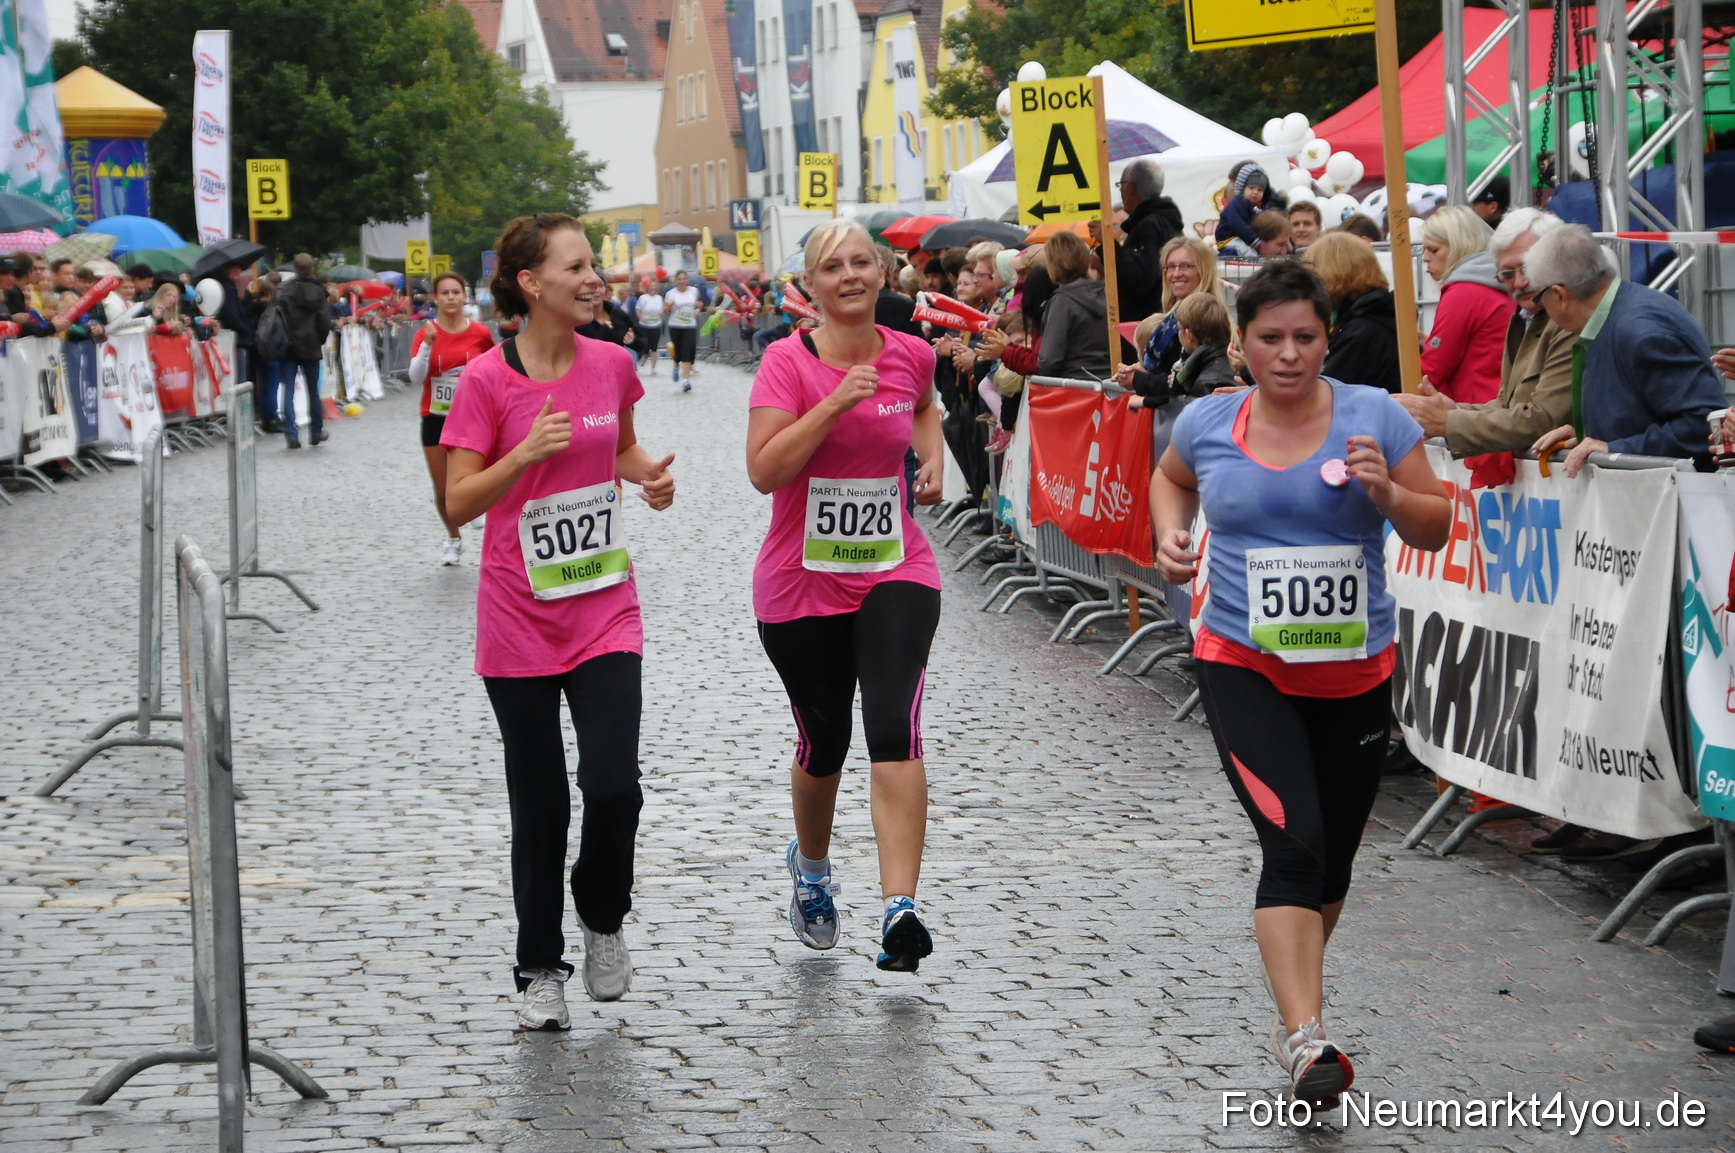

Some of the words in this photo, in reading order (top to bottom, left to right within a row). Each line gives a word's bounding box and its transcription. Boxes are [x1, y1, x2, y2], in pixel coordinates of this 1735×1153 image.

[1021, 83, 1094, 112] Block
[804, 155, 833, 166] Block
[1036, 122, 1090, 192] A
[251, 161, 282, 173] Block
[258, 177, 277, 205] B
[809, 171, 828, 198] B
[411, 249, 423, 266] C
[742, 241, 754, 258] C
[705, 256, 715, 270] D
[918, 308, 944, 322] Audi
[877, 400, 914, 416] Andrea
[583, 410, 617, 429] Nicole
[810, 486, 845, 497] PARTL
[847, 487, 888, 498] Neumarkt
[520, 504, 555, 521] PARTL
[557, 495, 604, 514] Neumarkt
[817, 501, 893, 537] 5028
[531, 507, 613, 561] 5027
[1397, 480, 1562, 606] ERSPORT
[832, 545, 876, 560] Andrea
[561, 560, 603, 582] Nicole
[1249, 559, 1291, 571] PARTL
[1293, 557, 1352, 570] Neumarkt
[1262, 574, 1359, 619] 5039
[1279, 629, 1342, 646] Gordana
